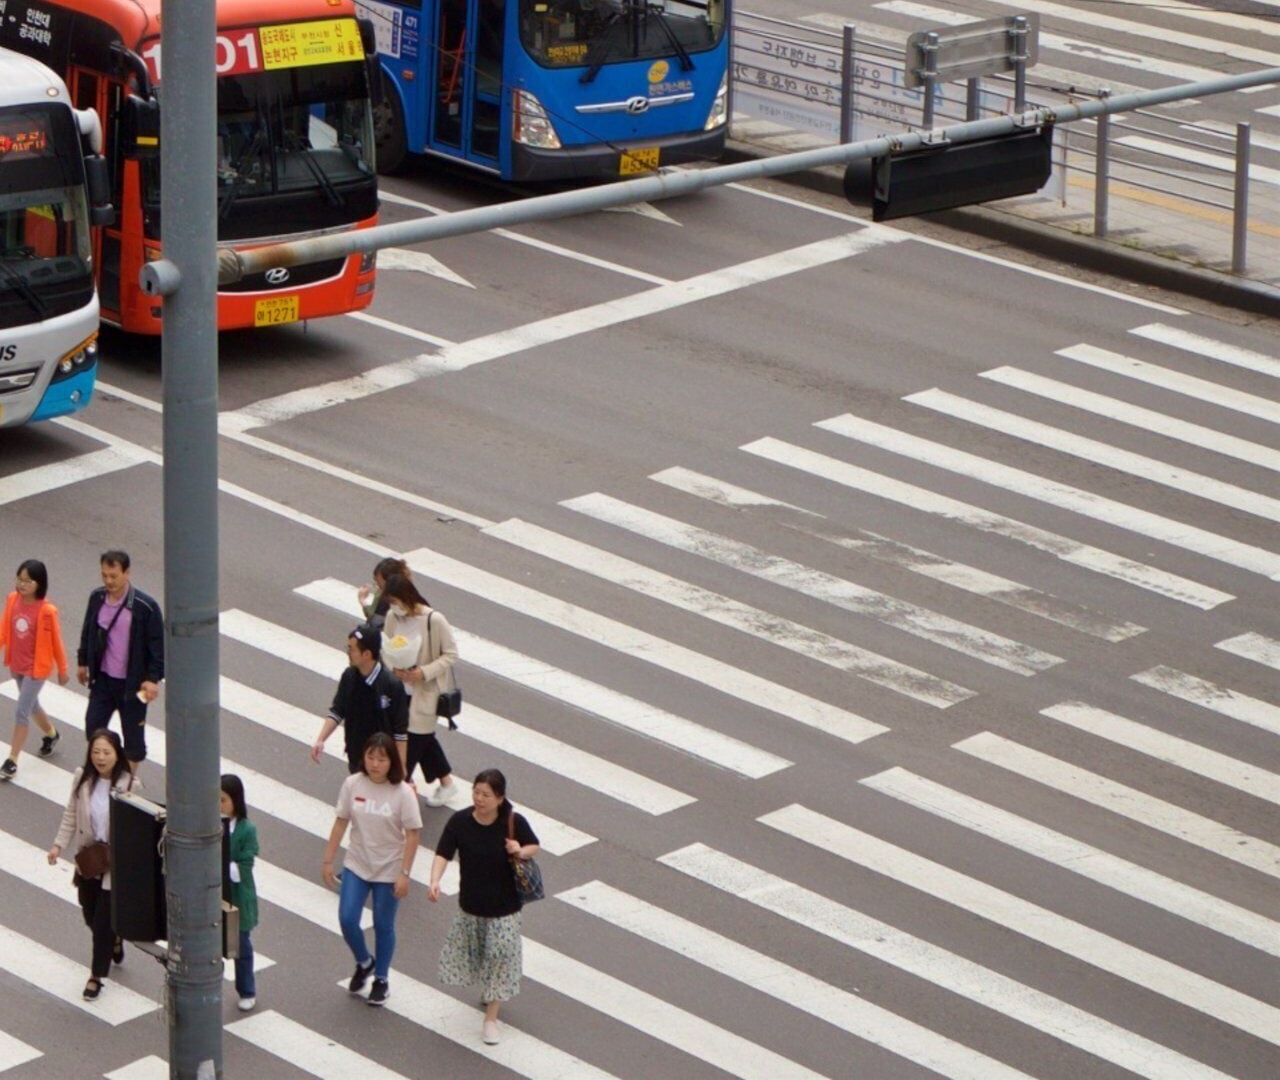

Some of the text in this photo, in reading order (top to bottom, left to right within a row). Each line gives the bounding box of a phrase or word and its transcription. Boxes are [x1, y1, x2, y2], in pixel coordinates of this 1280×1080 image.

[142, 32, 258, 80] 101
[265, 46, 298, 65] 논현지구
[353, 797, 393, 816] FILA
